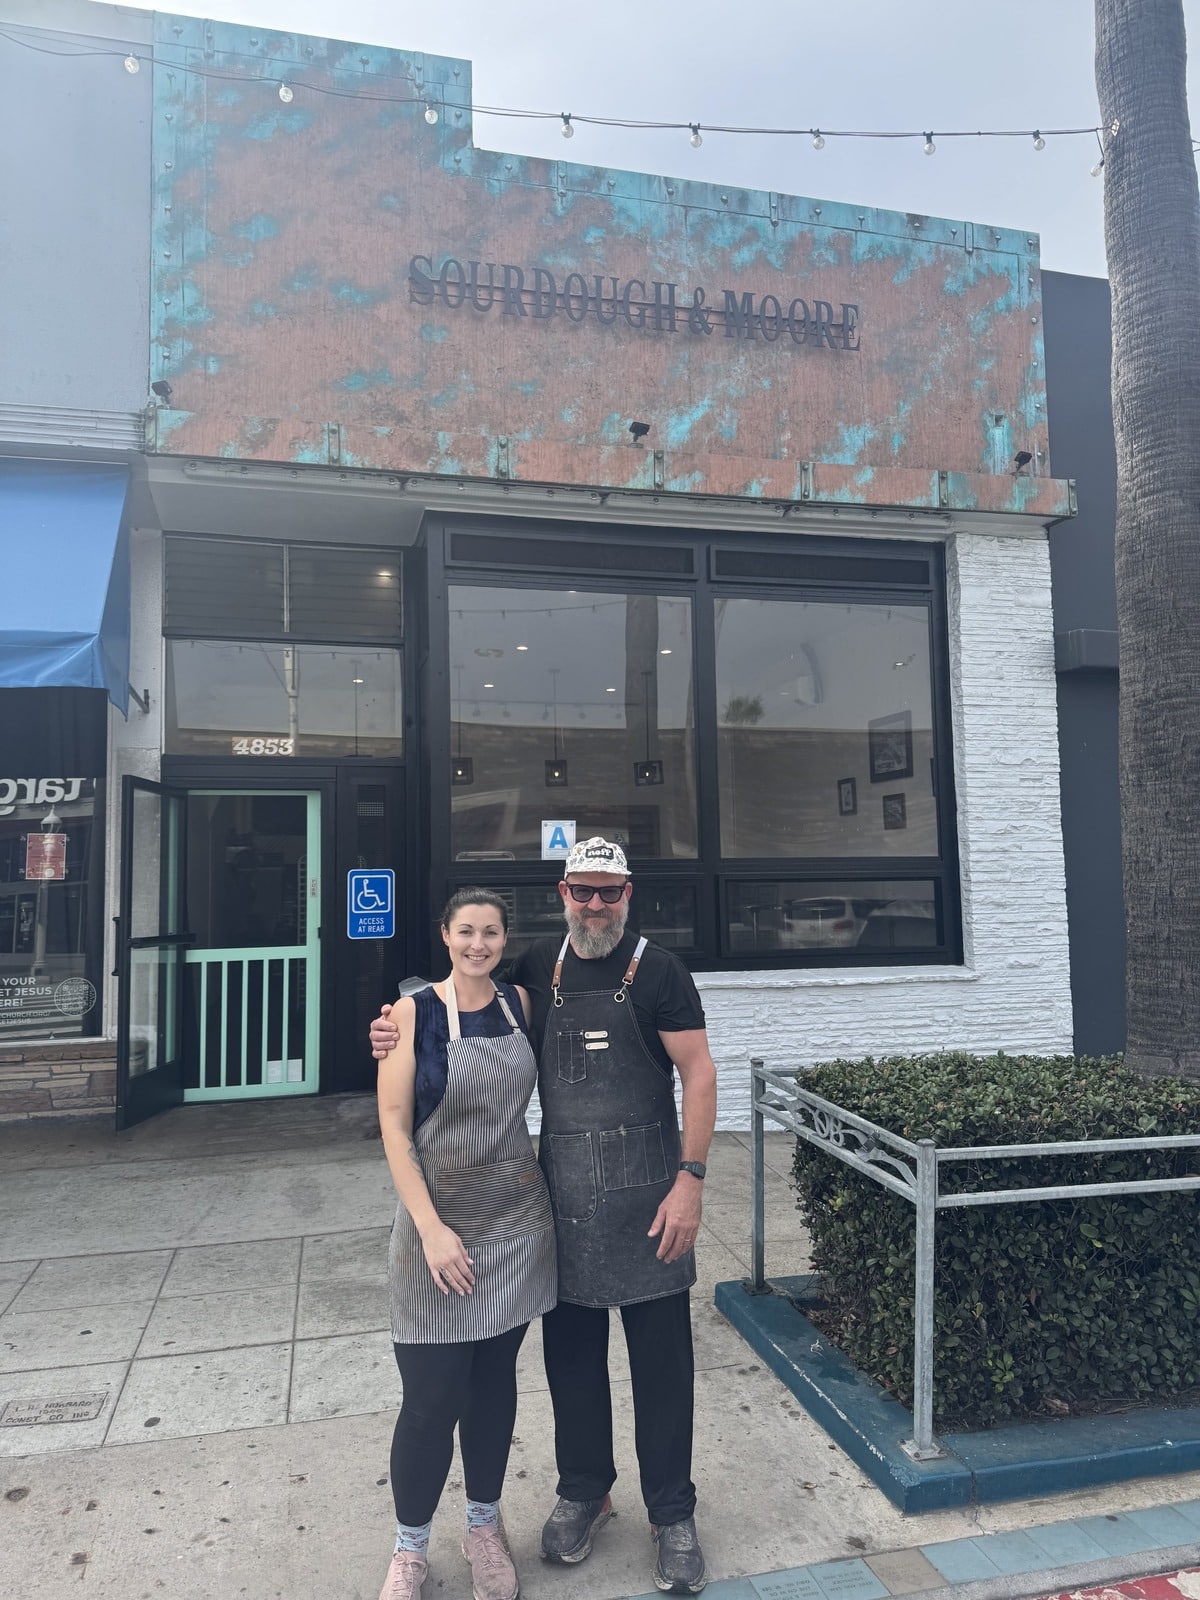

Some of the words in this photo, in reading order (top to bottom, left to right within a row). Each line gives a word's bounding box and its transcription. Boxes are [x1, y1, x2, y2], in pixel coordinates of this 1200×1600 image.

[409, 254, 679, 332] SOURDOUGH
[688, 287, 714, 336] &
[722, 288, 861, 351] MOORE
[233, 738, 294, 755] 4853
[549, 826, 568, 848] A
[358, 917, 384, 925] ACCESS
[357, 925, 366, 933] AT
[368, 925, 385, 933] REAR
[2, 976, 36, 986] YOUR
[14, 986, 52, 996] JESUS
